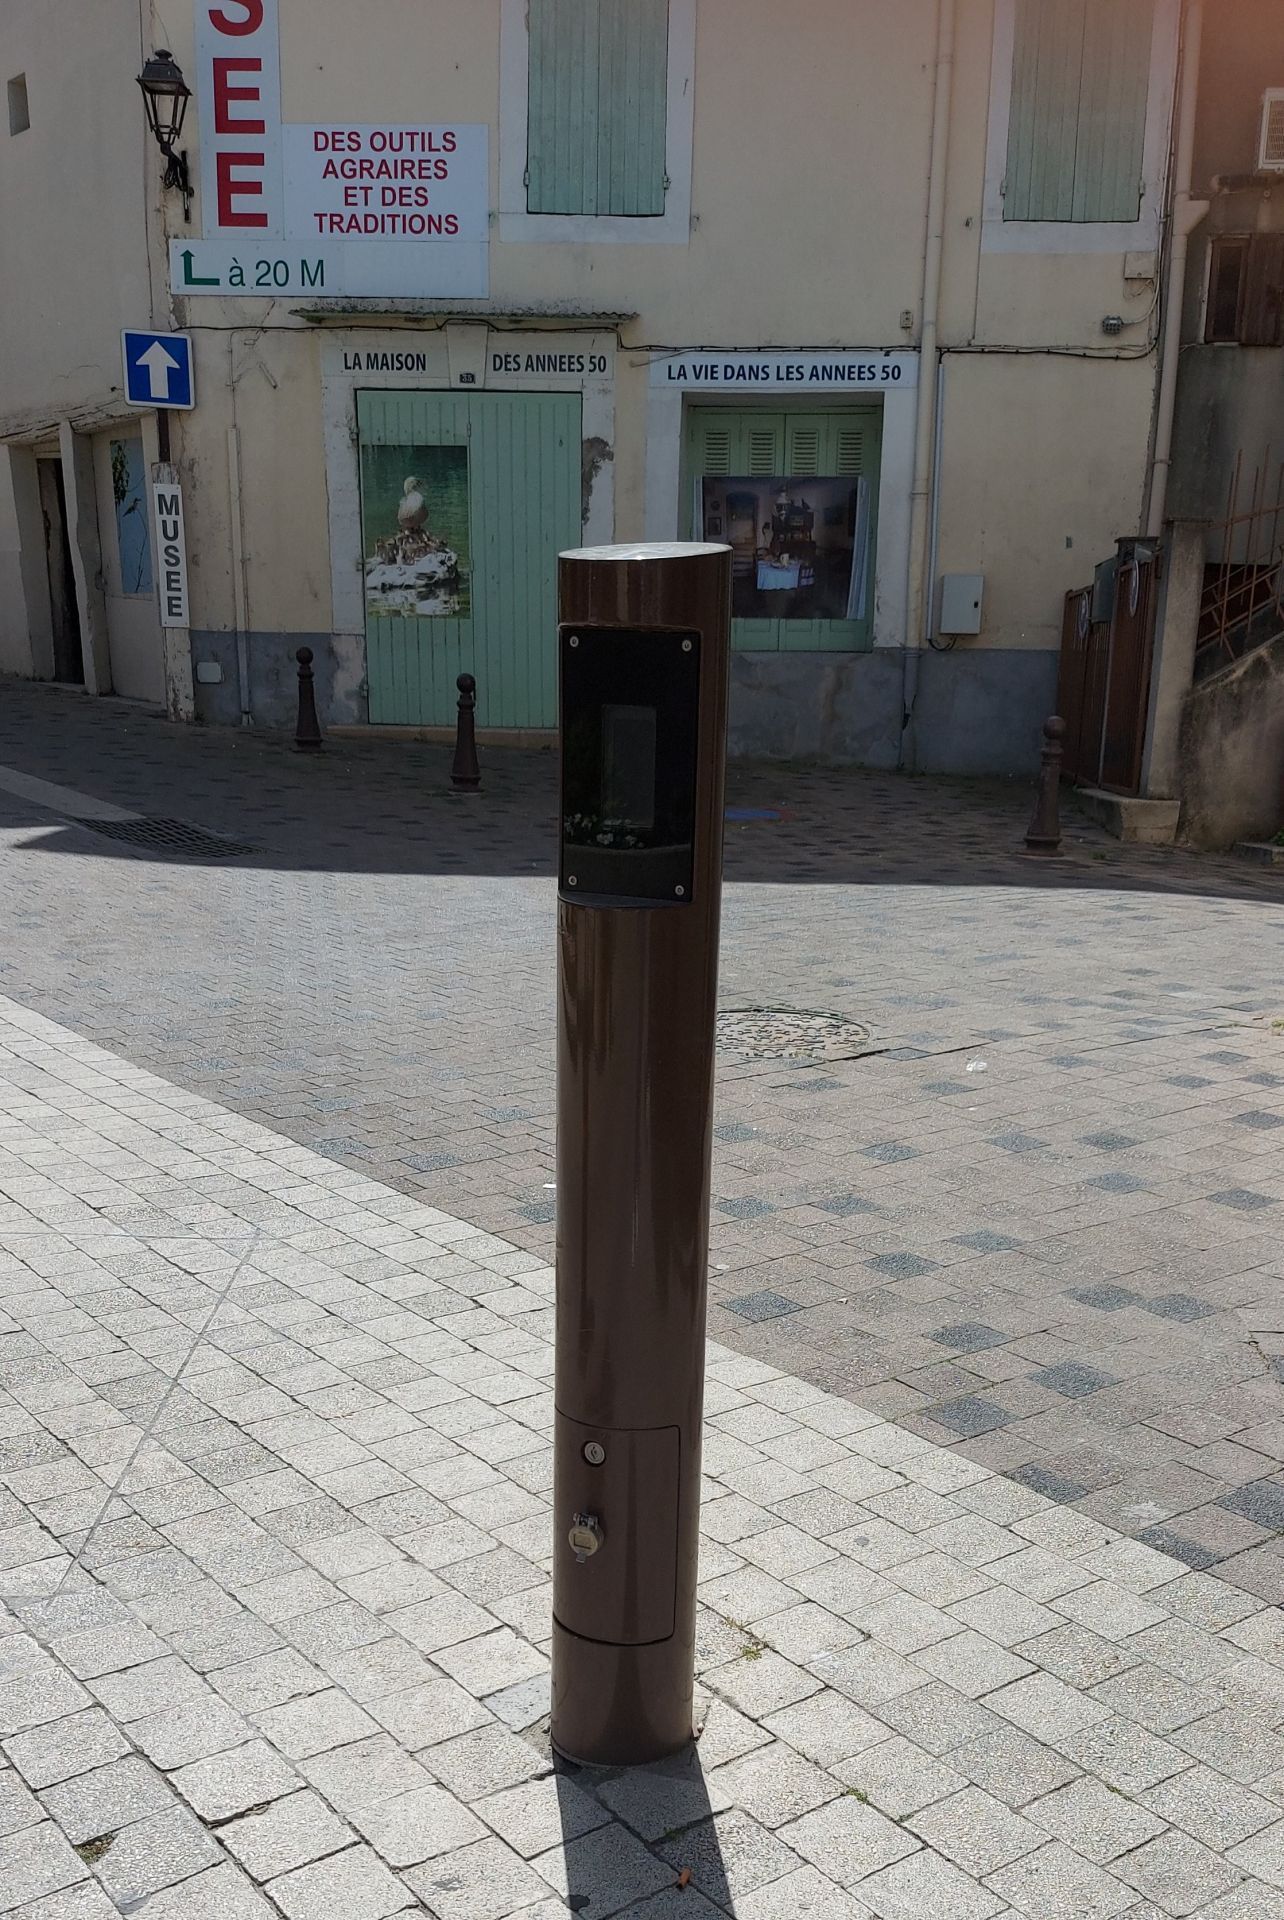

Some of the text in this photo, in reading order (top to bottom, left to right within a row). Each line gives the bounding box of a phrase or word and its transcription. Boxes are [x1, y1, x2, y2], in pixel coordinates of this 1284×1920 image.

[313, 131, 457, 152] DES OUTILS
[322, 159, 448, 180] AGRAIRES
[344, 187, 429, 207] ET DES
[314, 213, 459, 235] TRADITIONS
[228, 257, 325, 287] à 20 M
[344, 352, 426, 371] LA MAISON
[492, 353, 607, 373] DES ANNEES 50
[667, 365, 901, 381] LA VIE DANS LES ANNEES 50
[157, 494, 183, 617] MUSEE
